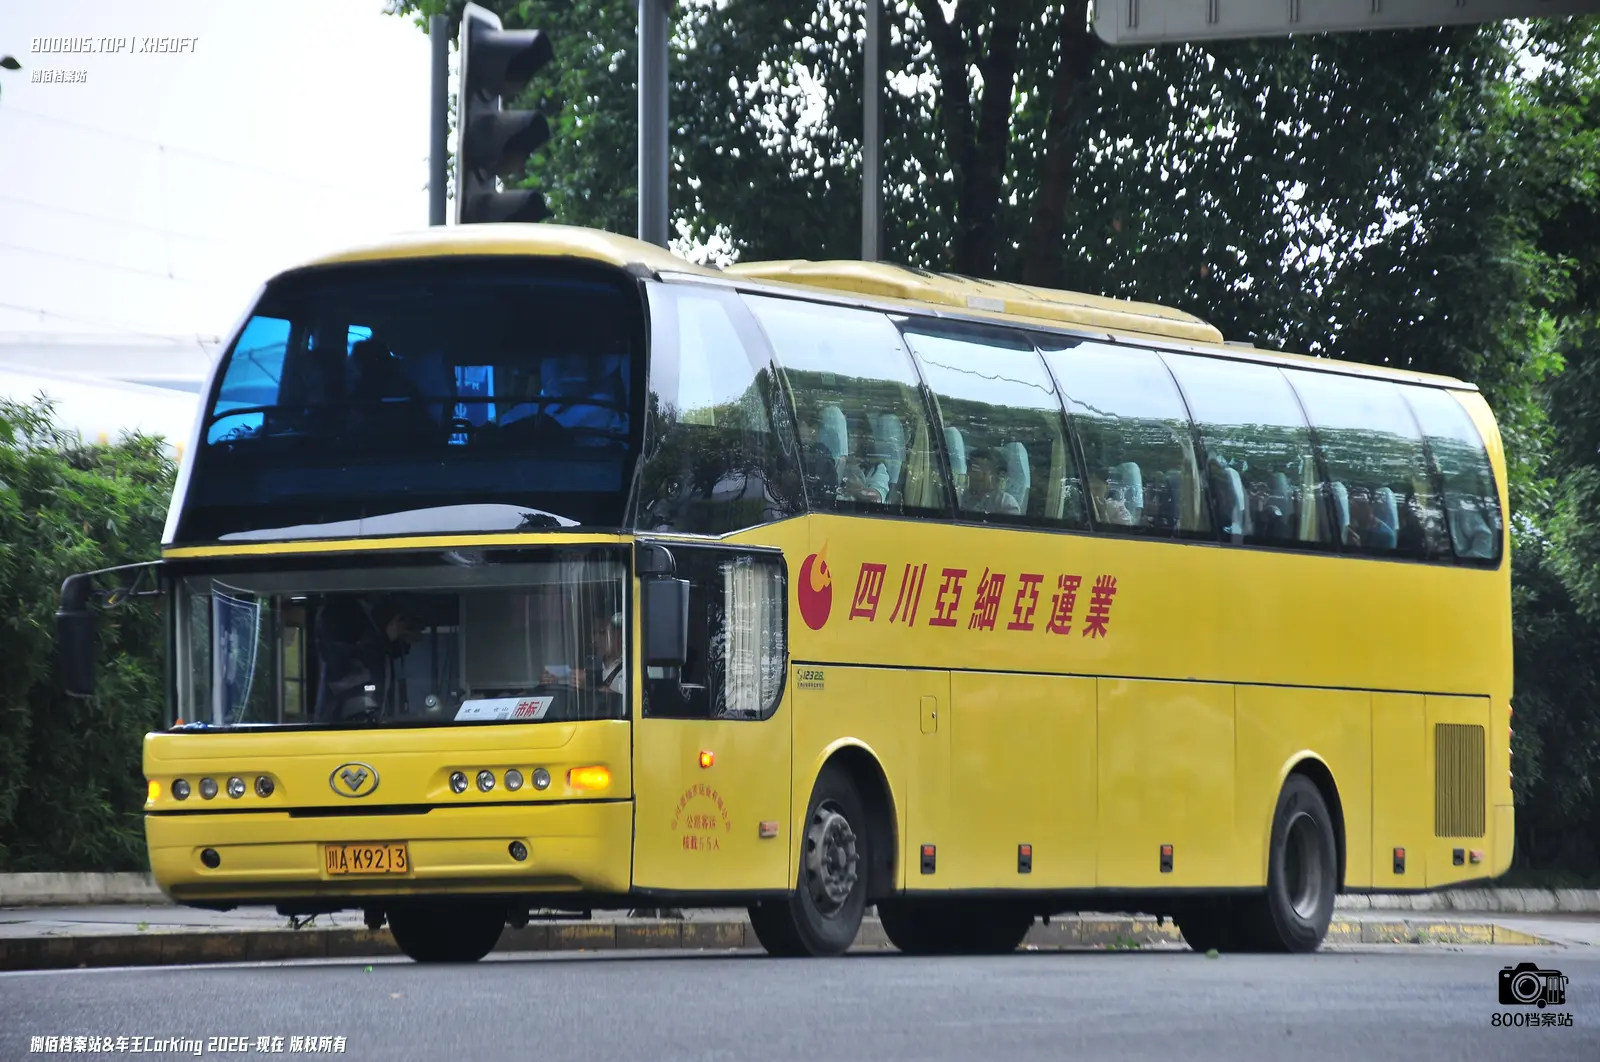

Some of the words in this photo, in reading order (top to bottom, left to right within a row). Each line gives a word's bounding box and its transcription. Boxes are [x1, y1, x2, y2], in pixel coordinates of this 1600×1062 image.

[848, 562, 1118, 639] 四川亞細亞運業
